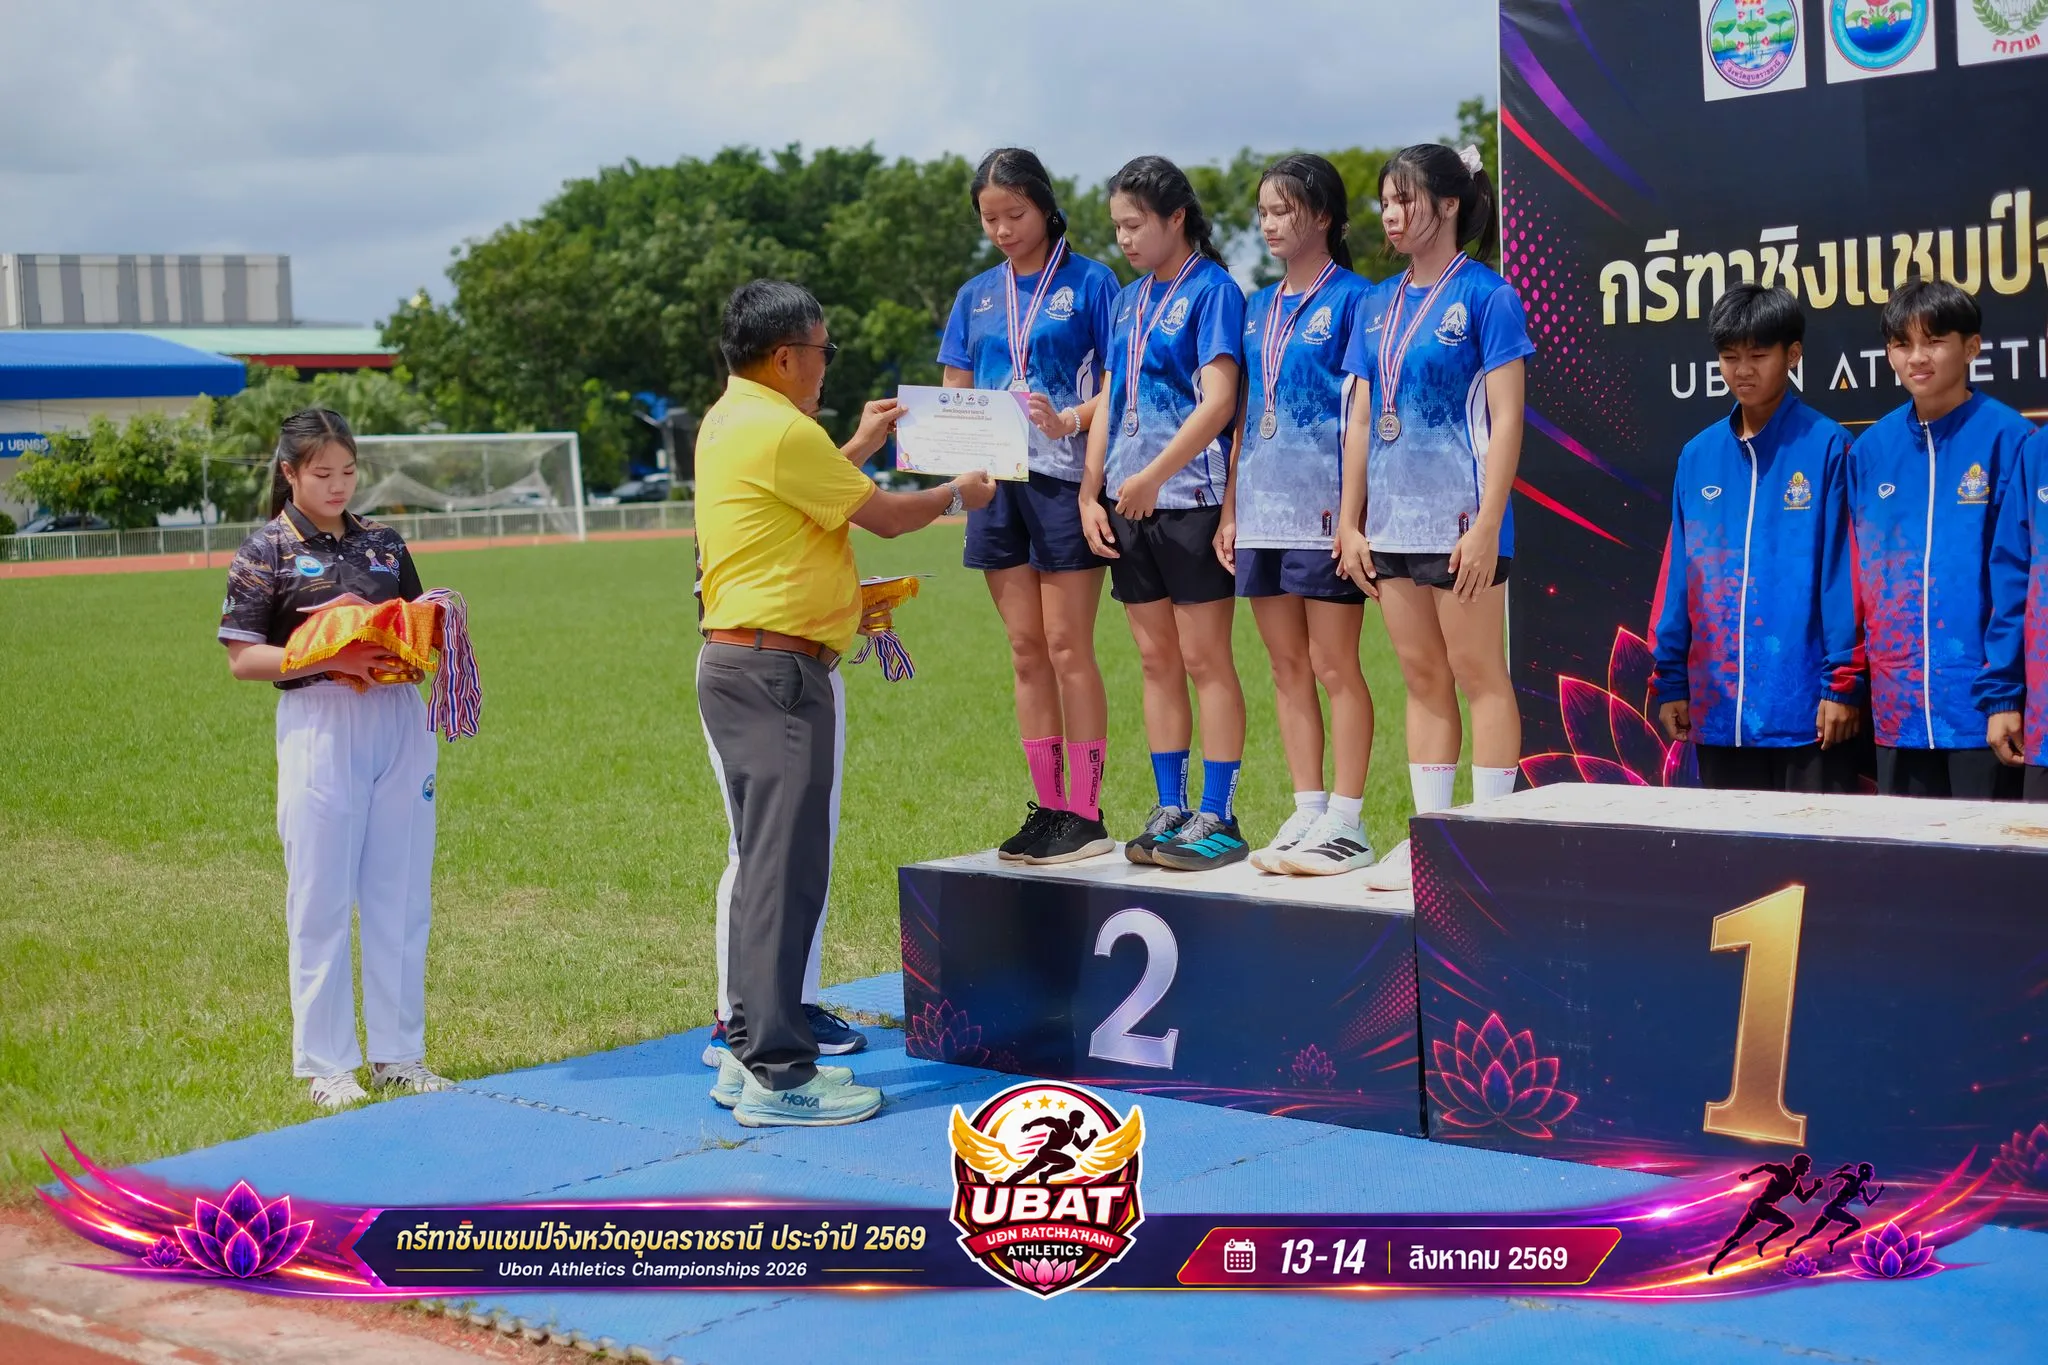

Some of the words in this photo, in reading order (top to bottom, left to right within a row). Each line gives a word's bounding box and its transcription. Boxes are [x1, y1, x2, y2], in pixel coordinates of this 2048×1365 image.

[1599, 188, 2048, 326] กรีฑาชิงแชมป์
[1670, 355, 1804, 399] UBN
[1828, 338, 2047, 391] ATETI
[1088, 908, 1180, 1070] 2
[1703, 884, 1807, 1147] 1
[781, 1091, 820, 1109] HOKA
